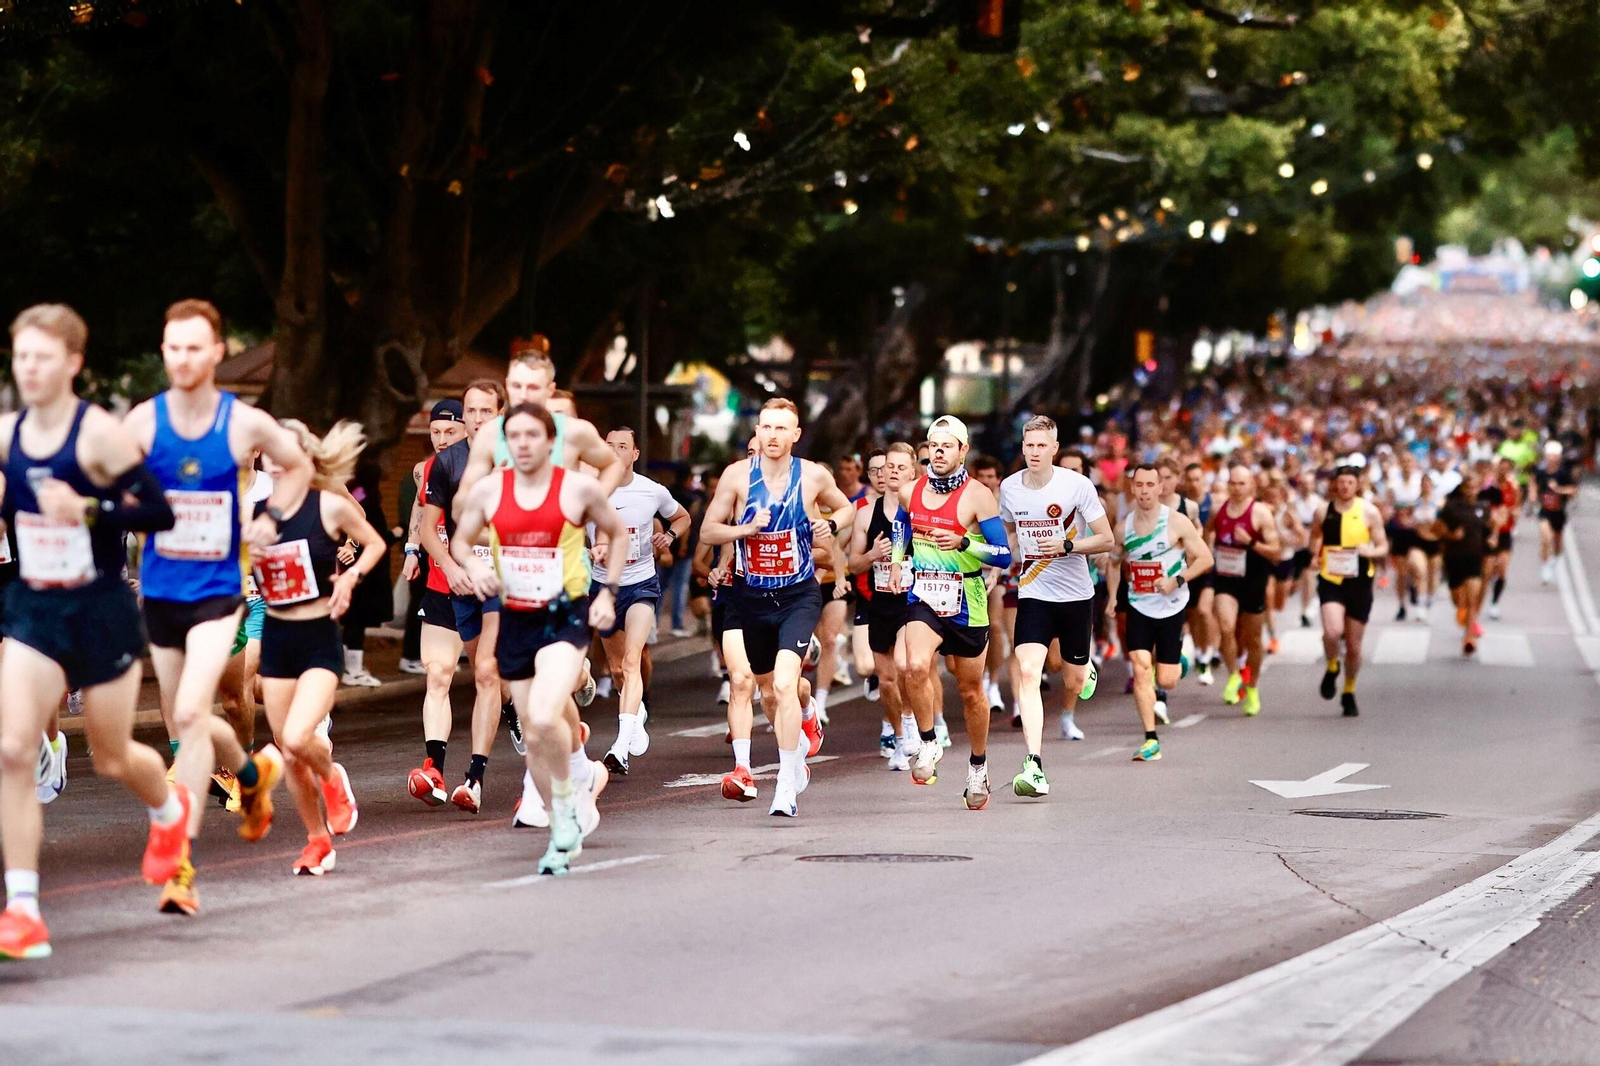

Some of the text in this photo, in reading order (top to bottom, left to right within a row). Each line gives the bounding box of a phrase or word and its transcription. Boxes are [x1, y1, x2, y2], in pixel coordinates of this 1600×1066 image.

[1026, 529, 1053, 538] 14600
[759, 544, 778, 552] 269
[922, 583, 950, 592] 15179
